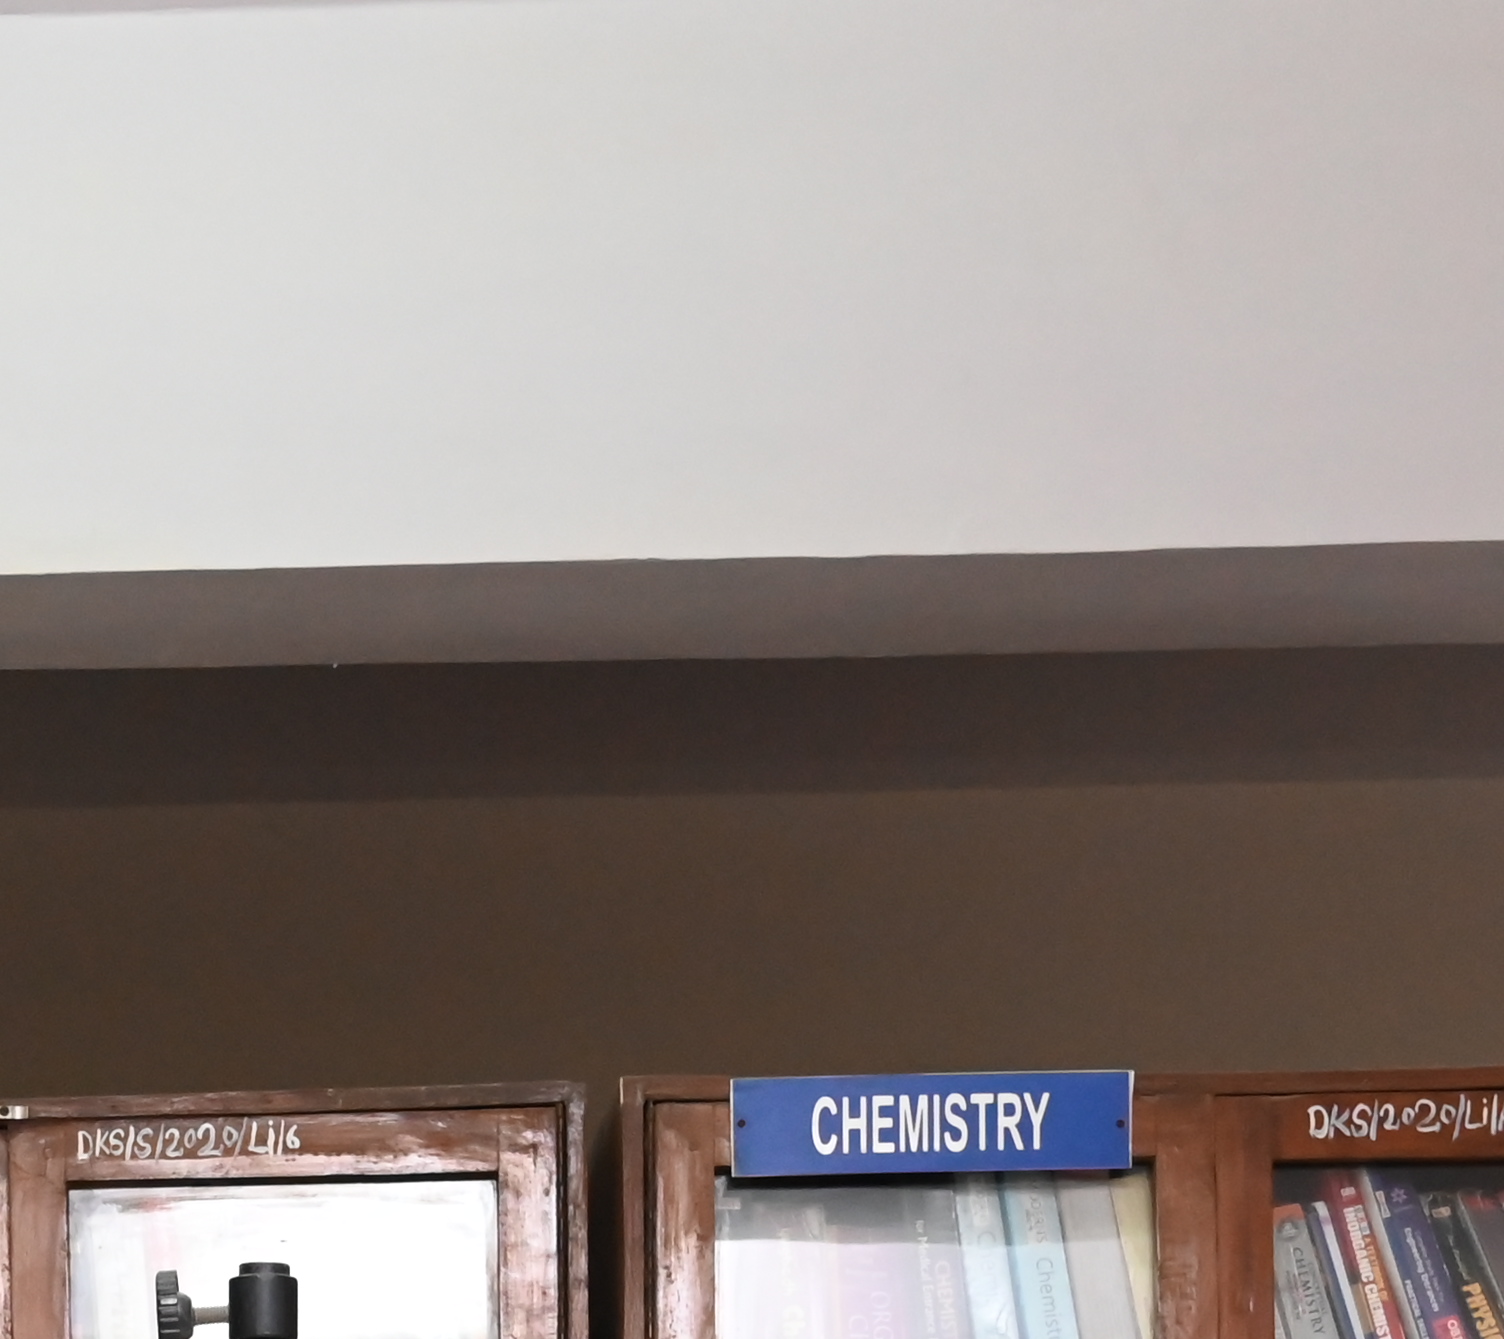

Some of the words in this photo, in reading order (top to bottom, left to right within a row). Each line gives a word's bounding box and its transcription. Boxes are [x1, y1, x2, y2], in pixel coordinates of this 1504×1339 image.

[811, 1092, 1050, 1155] CHEMISTRY
[1342, 1206, 1376, 1283] INORGANIC
[1292, 1247, 1326, 1335] CHEMISTRY
